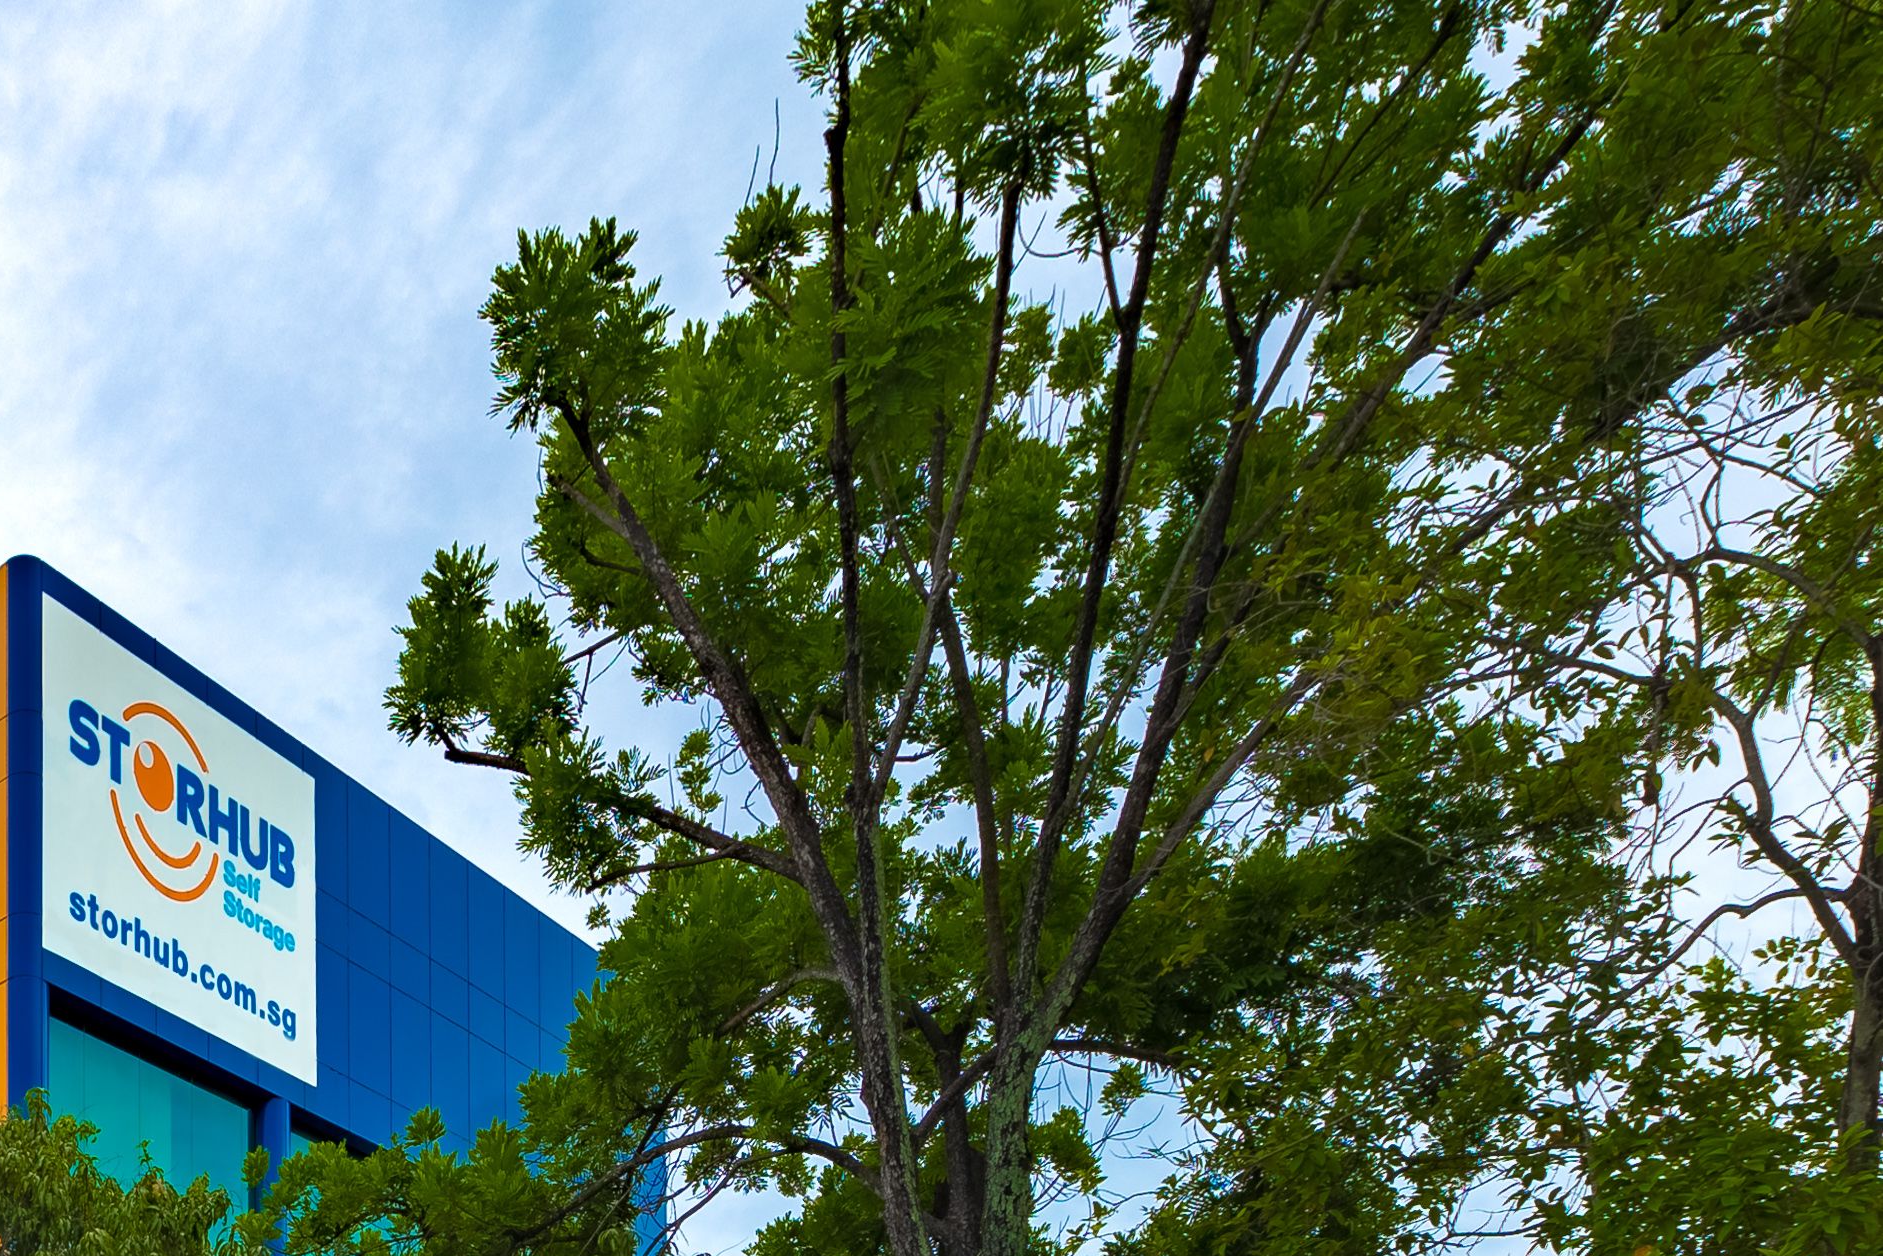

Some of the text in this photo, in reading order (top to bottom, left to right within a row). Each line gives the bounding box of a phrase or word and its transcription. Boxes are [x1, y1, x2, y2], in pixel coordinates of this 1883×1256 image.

[68, 699, 295, 889] STORHUB
[223, 860, 261, 903] Self
[223, 891, 295, 952] Storage
[68, 891, 296, 1042] storhub.com.sg
